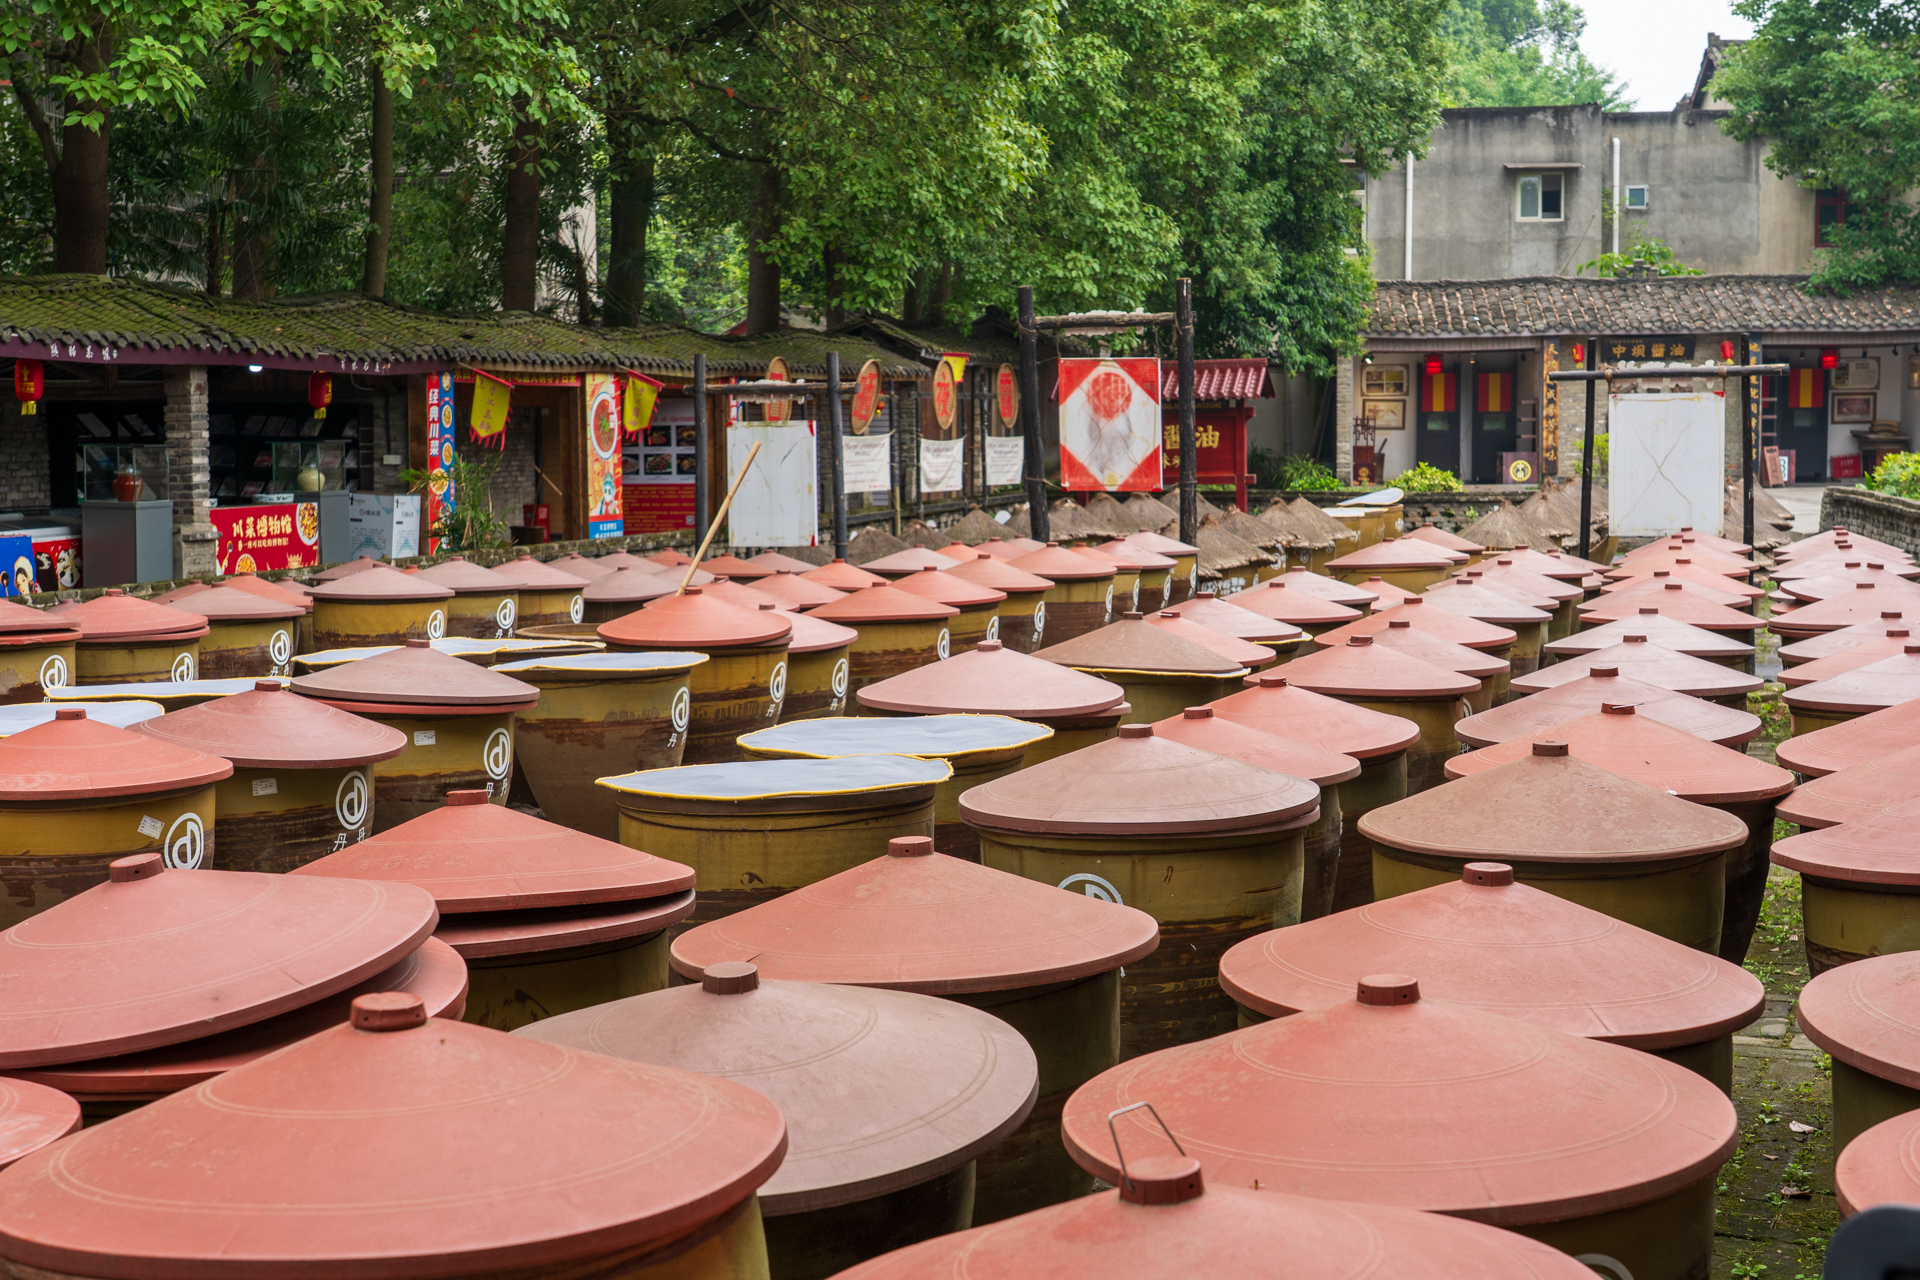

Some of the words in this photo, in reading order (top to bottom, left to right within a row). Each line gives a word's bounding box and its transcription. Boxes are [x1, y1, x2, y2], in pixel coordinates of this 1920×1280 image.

[429, 388, 440, 457] 经典川菜
[232, 514, 292, 538] 川菜博物馆
